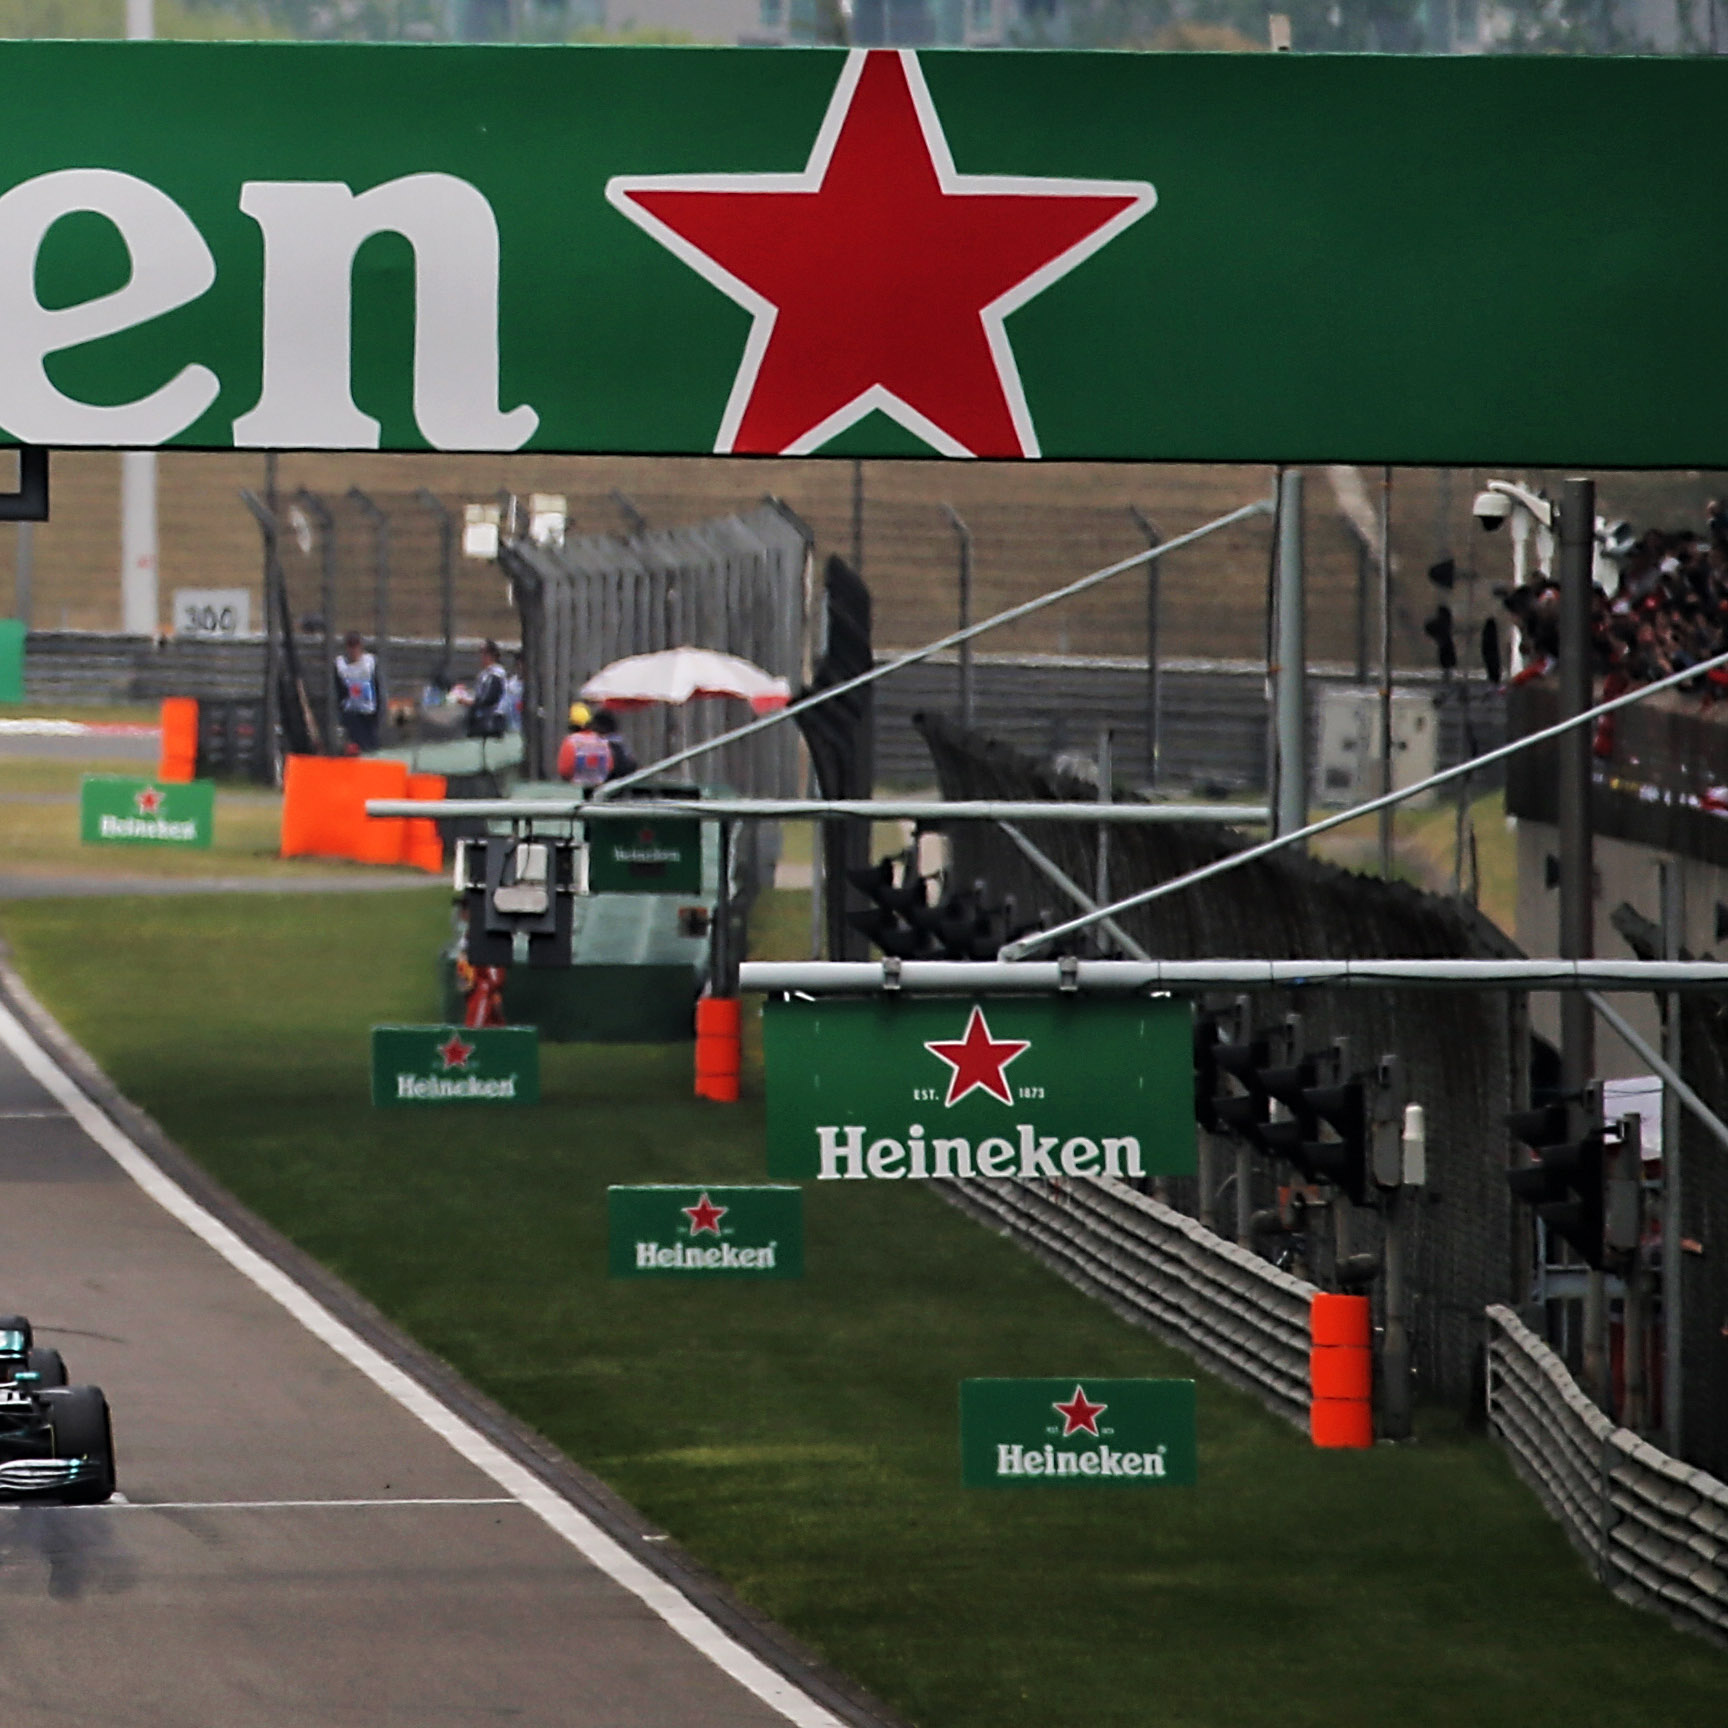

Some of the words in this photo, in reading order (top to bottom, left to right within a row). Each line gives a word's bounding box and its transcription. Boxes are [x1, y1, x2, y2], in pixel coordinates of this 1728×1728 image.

[397, 1074, 516, 1098] Heineken
[913, 1088, 939, 1101] EST.
[1018, 1087, 1045, 1099] 1873
[815, 1123, 1147, 1180] Heineken
[635, 1241, 776, 1269] Heineken
[997, 1443, 1166, 1476] Heineken
